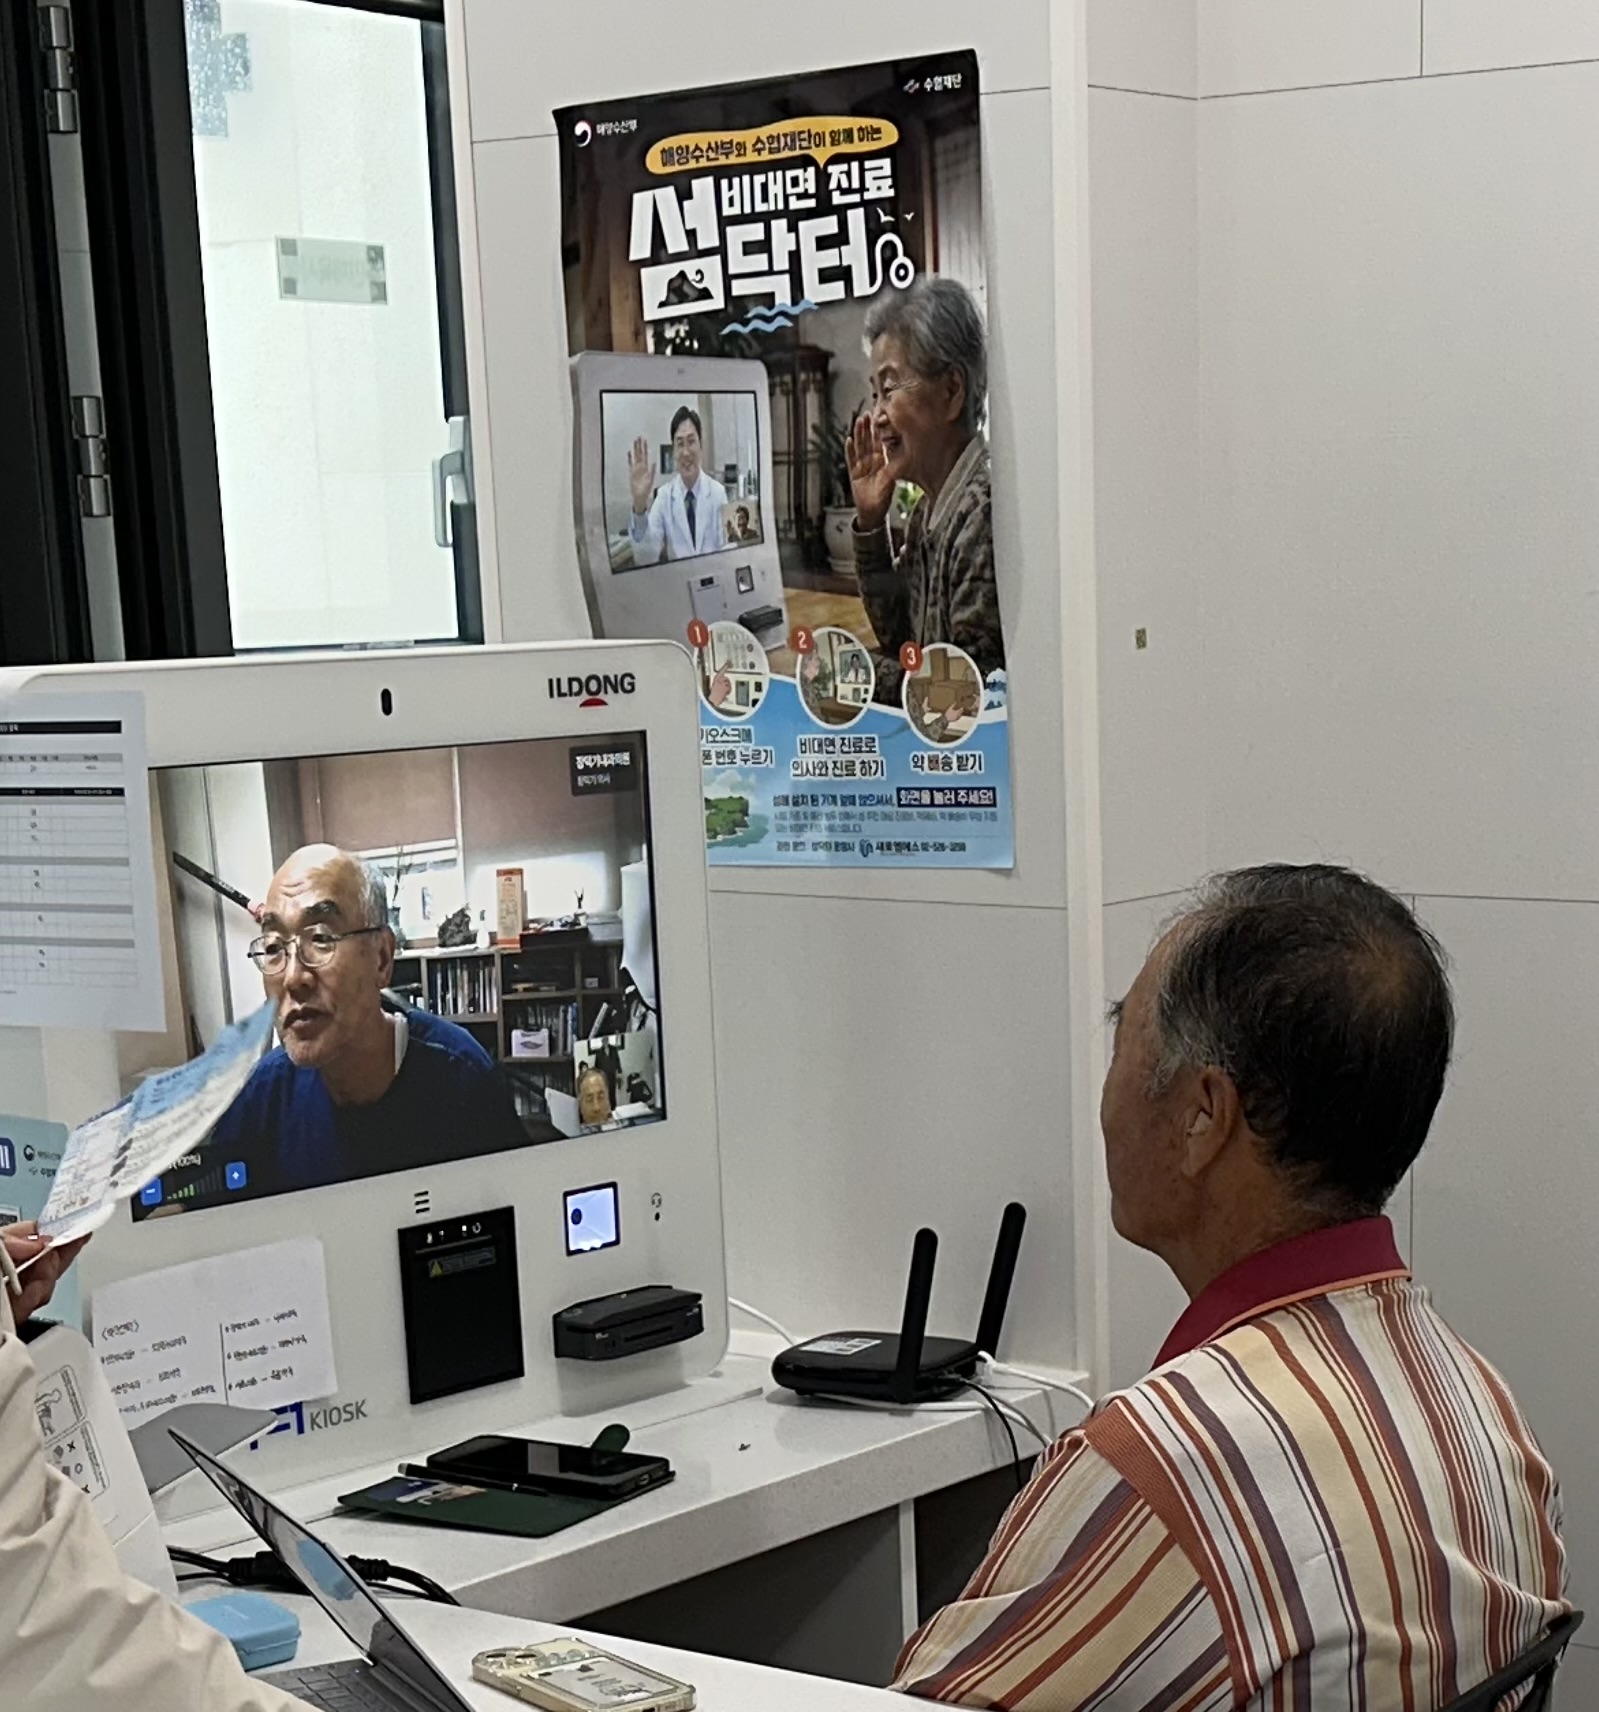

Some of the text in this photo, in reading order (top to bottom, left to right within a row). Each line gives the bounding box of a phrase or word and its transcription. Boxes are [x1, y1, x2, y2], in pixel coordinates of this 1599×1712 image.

[923, 73, 963, 92] 수협재단
[660, 139, 747, 167] 해양수산부와
[751, 128, 826, 155] 수협재단이
[857, 124, 882, 143] 하는
[720, 158, 895, 216] 비대면 진료
[629, 176, 725, 321] 섬
[725, 207, 876, 307] 닥터
[548, 672, 636, 699] ILDONG
[715, 749, 737, 765] 번호
[740, 748, 773, 765] 누르기
[799, 736, 877, 754] 비대면 진료로
[792, 759, 885, 777] 의사와 진료 하기
[911, 753, 925, 771] 약
[956, 753, 982, 772] 받기
[309, 1399, 368, 1431] KIOSK
